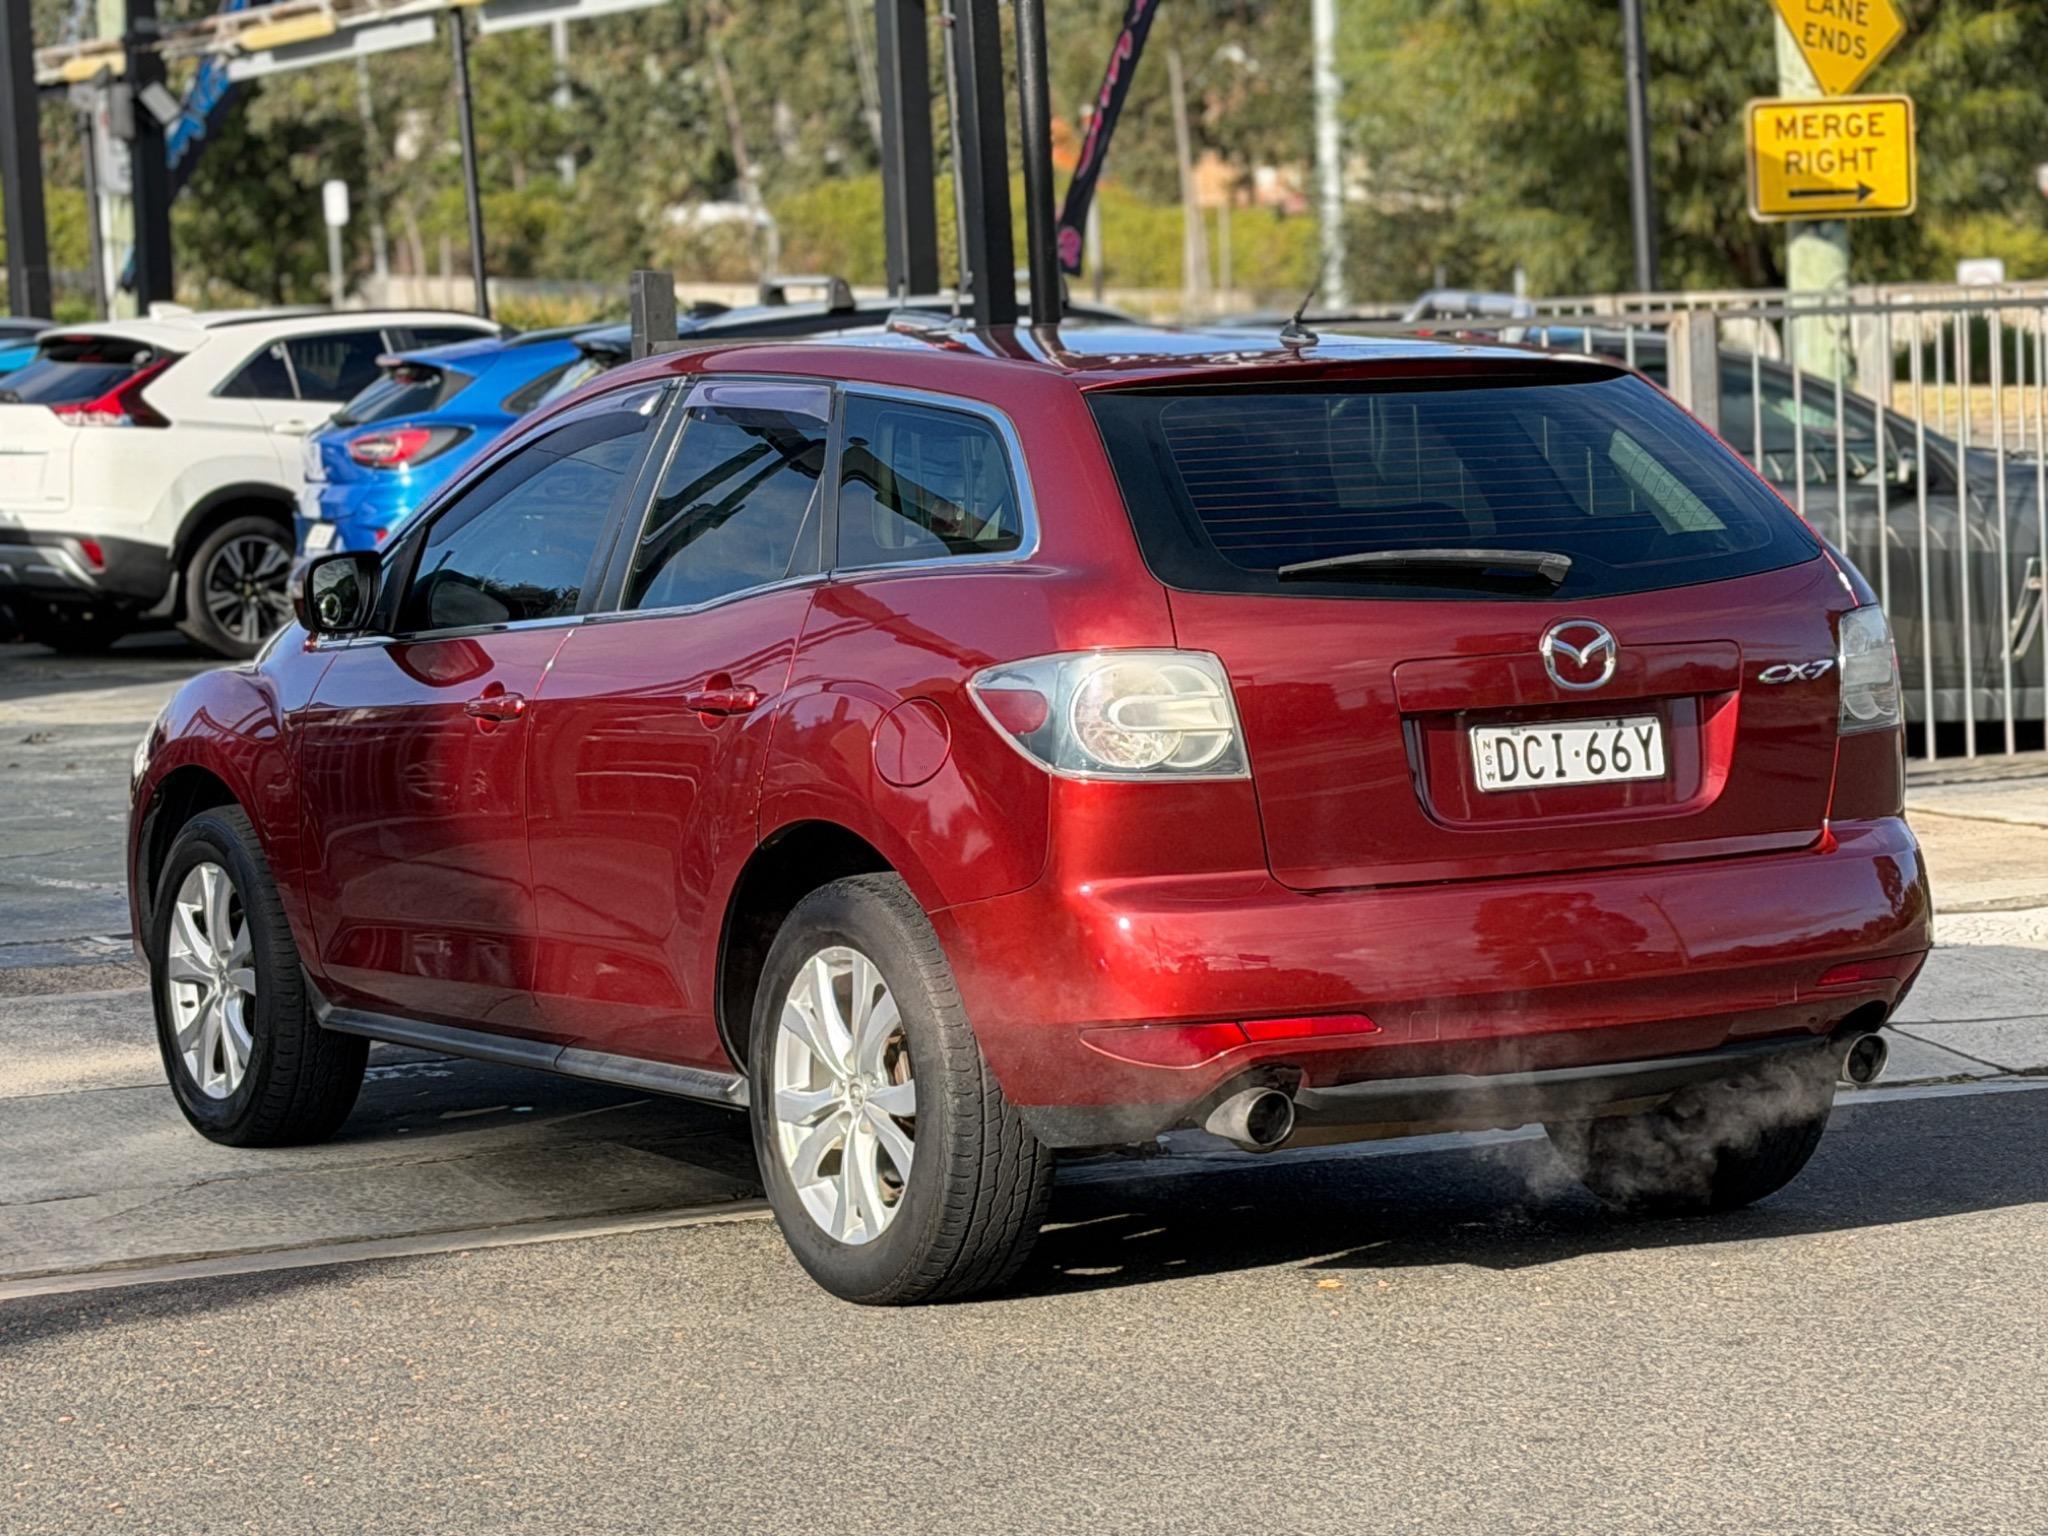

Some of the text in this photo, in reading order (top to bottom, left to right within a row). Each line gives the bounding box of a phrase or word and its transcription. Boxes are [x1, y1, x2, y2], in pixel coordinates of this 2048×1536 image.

[1805, 0, 1869, 27] LANE
[1803, 22, 1867, 60] ENDS
[1776, 112, 1885, 140] MERGE
[1784, 147, 1877, 175] RIGHT
[1758, 659, 1834, 685] CX-7
[1482, 739, 1496, 782] NSW
